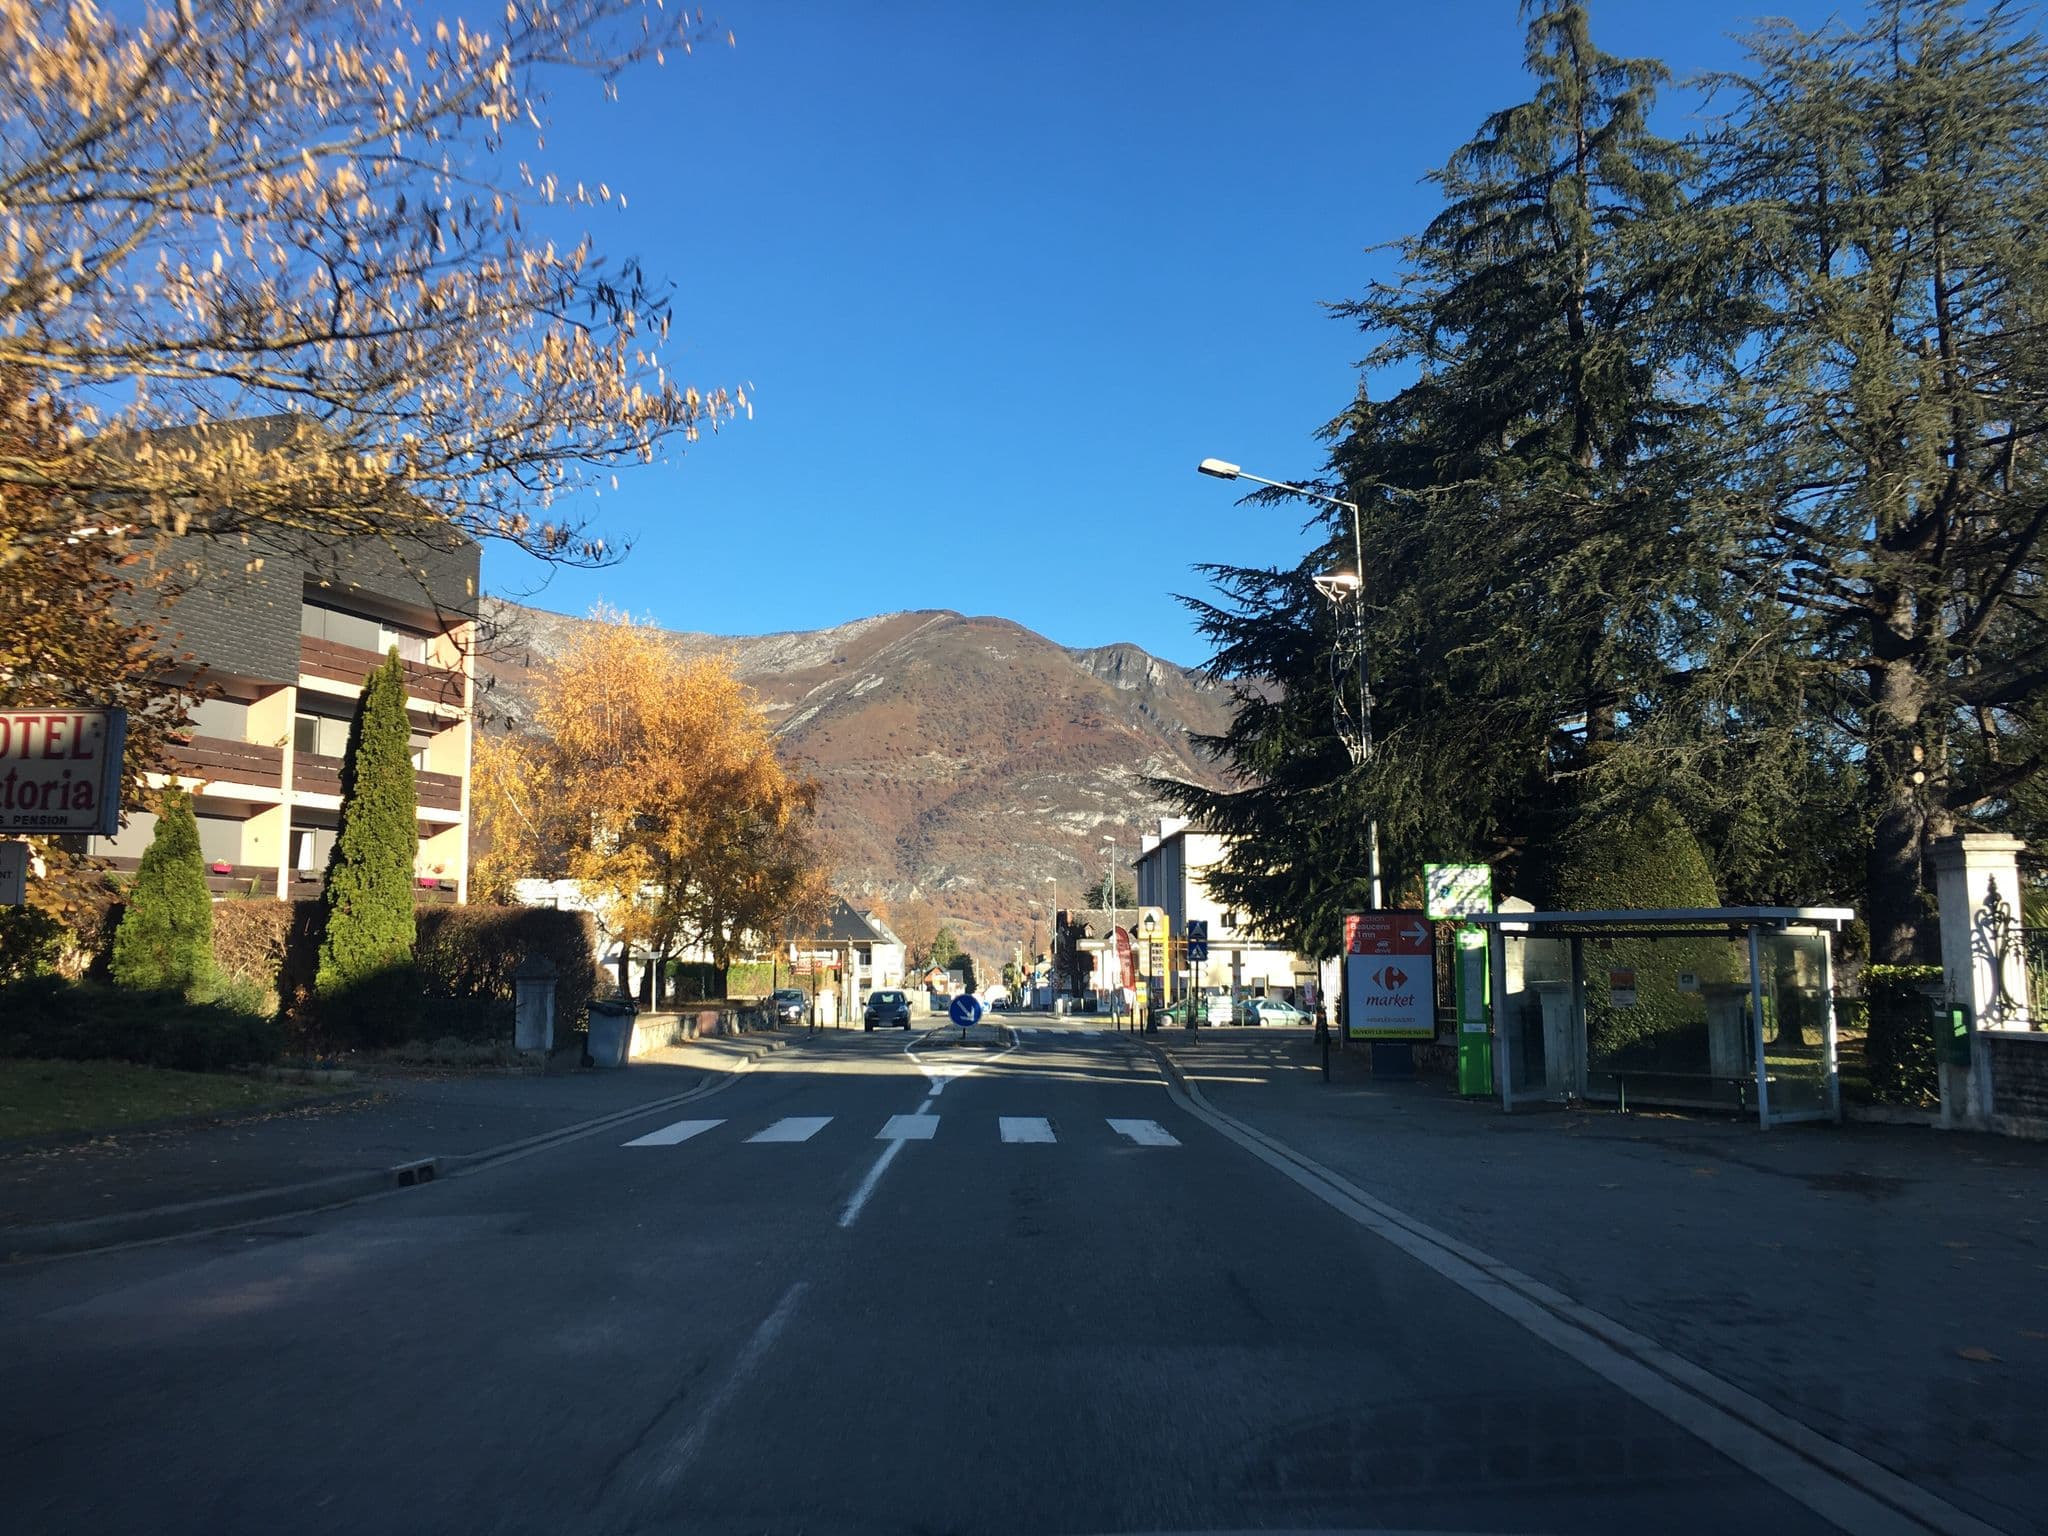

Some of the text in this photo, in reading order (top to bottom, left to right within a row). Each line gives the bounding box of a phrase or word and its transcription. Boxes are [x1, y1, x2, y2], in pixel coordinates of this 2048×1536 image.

[0, 767, 95, 810] toria
[13, 816, 68, 825] PENSION
[1366, 994, 1415, 1007] market
